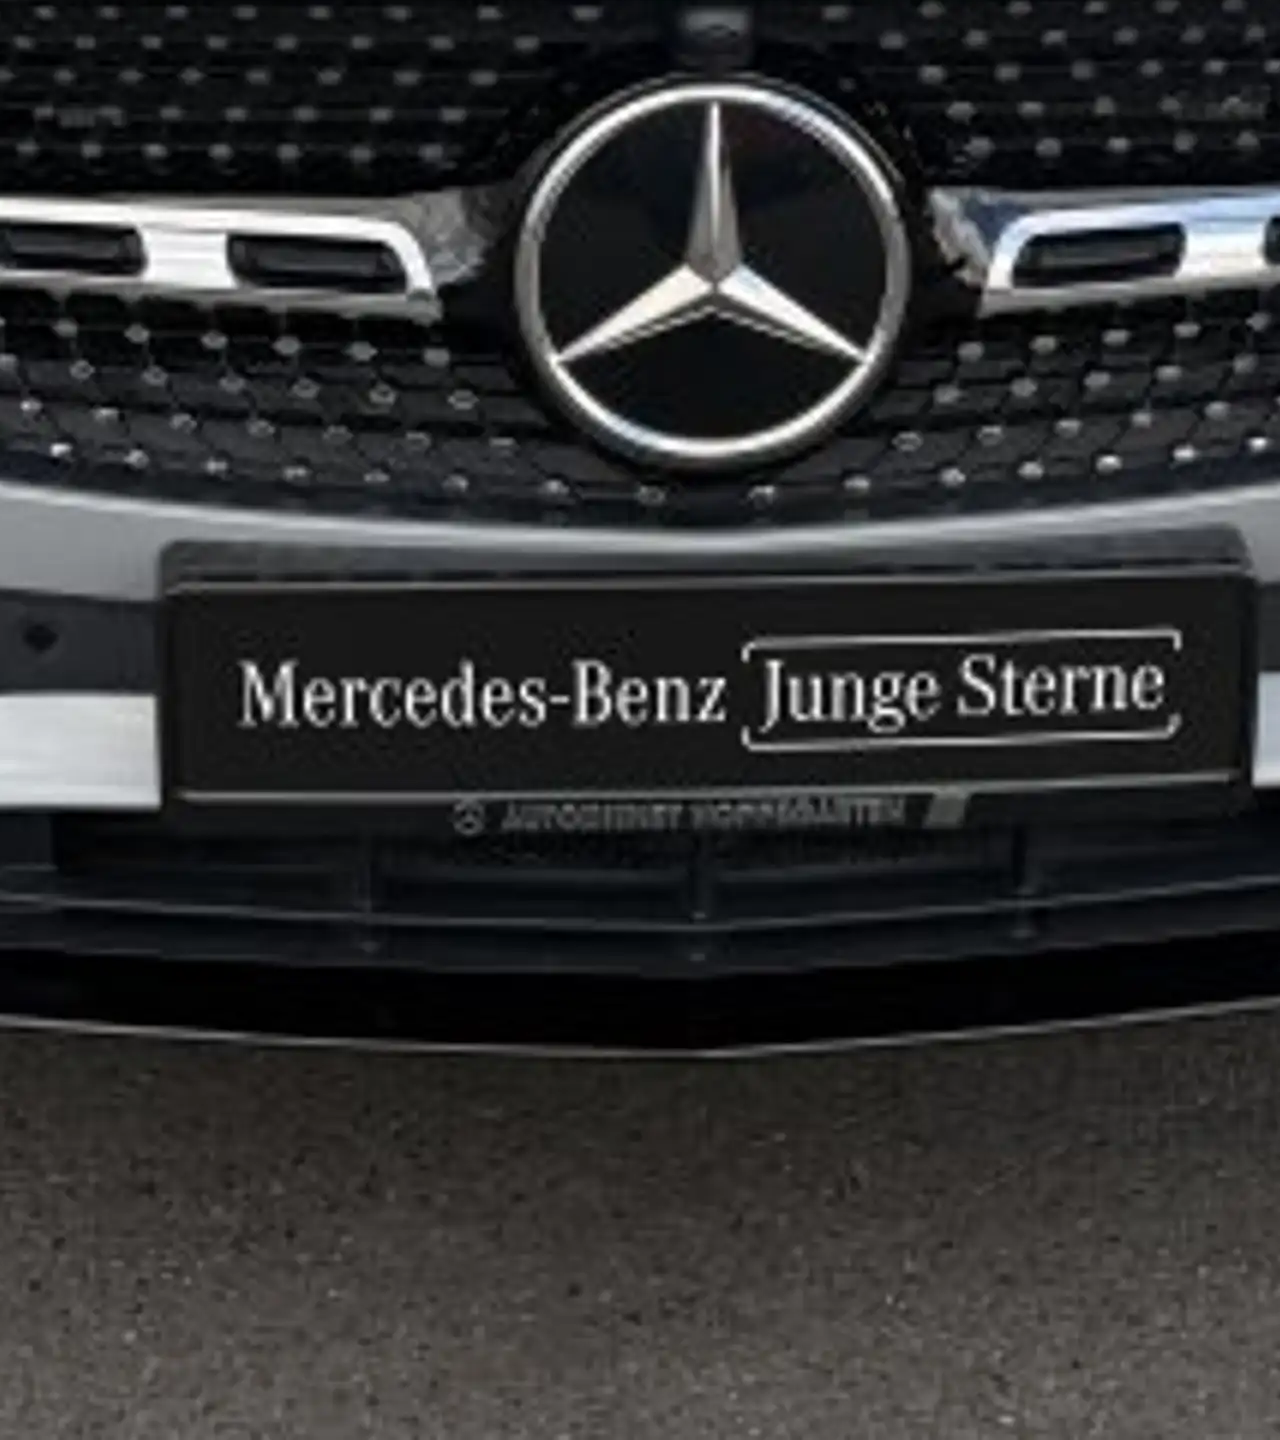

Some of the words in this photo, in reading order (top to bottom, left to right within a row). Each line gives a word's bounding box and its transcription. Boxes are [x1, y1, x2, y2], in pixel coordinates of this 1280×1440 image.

[237, 658, 728, 728] Mercedes-Benz
[760, 659, 942, 734] Junge
[956, 653, 1165, 716] Sterne
